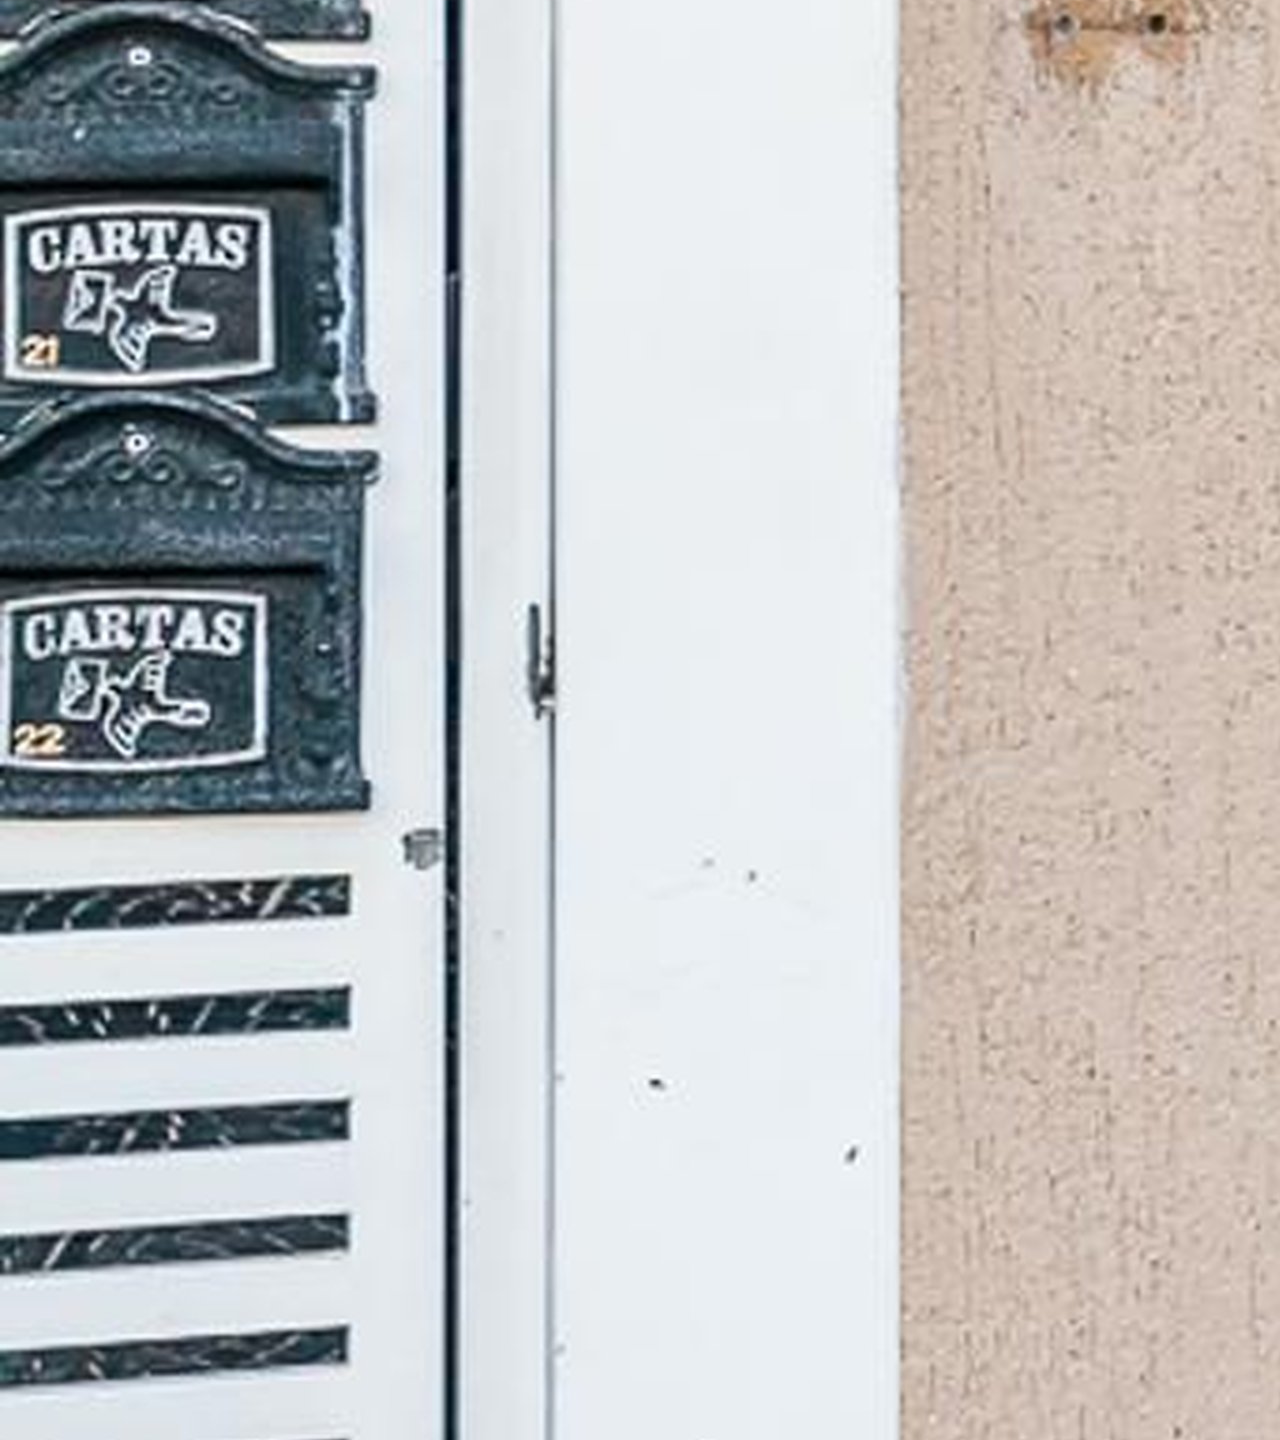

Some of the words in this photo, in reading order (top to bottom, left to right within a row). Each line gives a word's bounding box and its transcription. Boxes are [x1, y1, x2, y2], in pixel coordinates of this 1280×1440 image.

[28, 218, 249, 274] CARTAS
[20, 333, 60, 368] 21
[23, 602, 246, 661] CARTAS
[12, 723, 66, 757] 22
